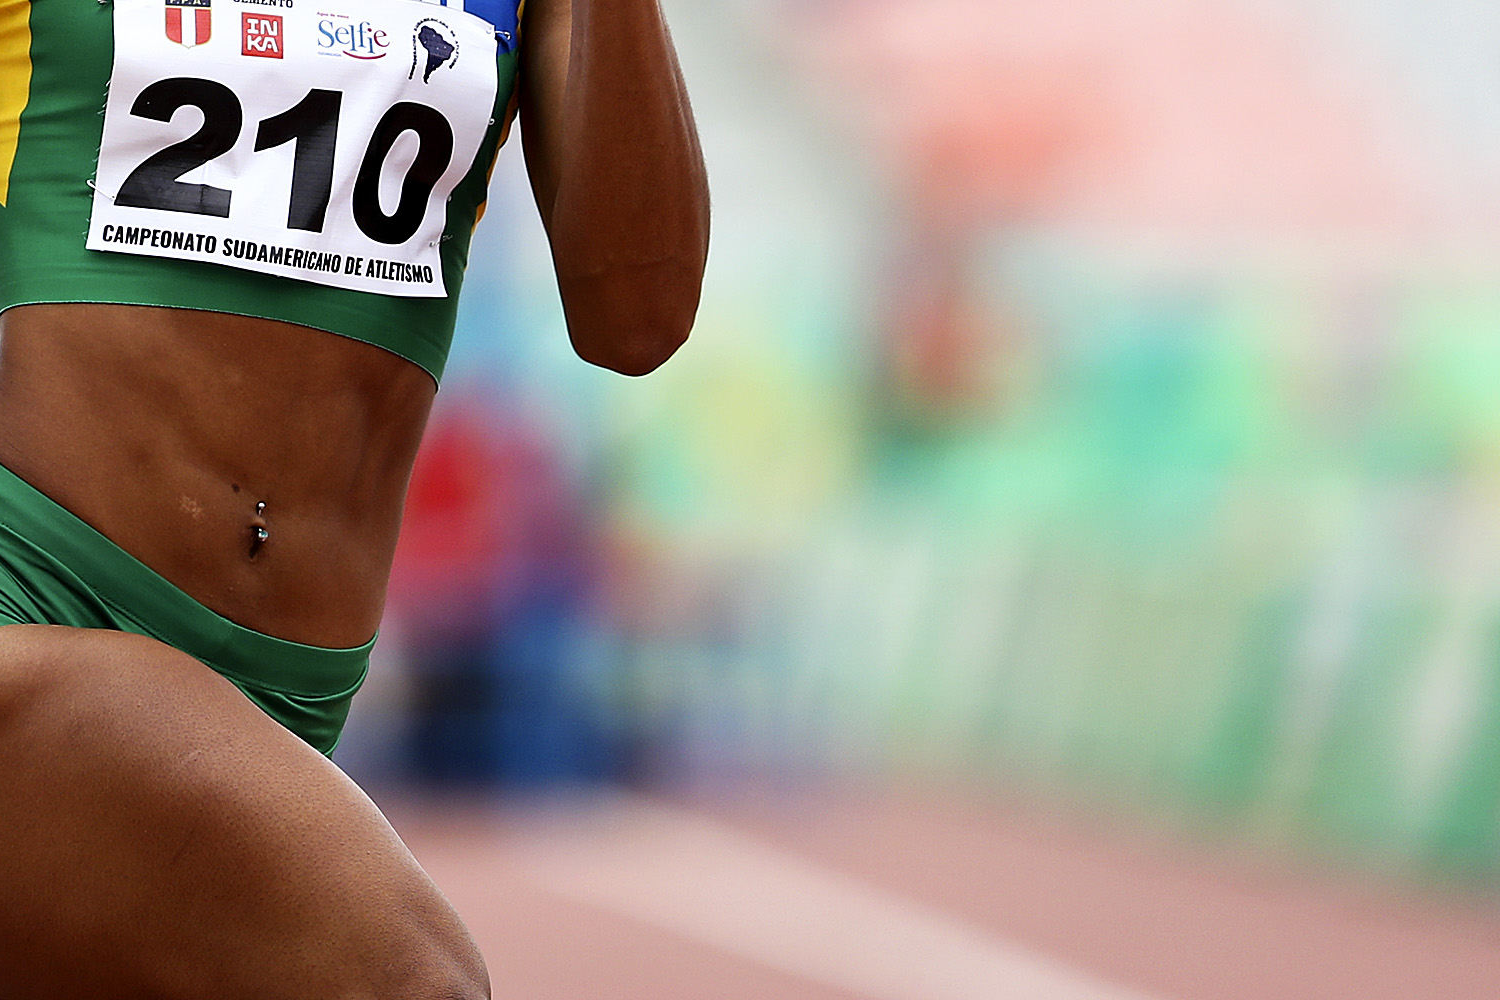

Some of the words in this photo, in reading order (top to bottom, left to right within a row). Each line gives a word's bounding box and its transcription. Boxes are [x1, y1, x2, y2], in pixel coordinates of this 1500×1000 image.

[317, 19, 390, 54] Selfie
[113, 77, 454, 245] 210
[102, 224, 217, 254] CAMPEONATO
[222, 238, 342, 273] SUDAMERICANO
[344, 256, 364, 276] DE
[365, 259, 433, 284] ATLETISMO
